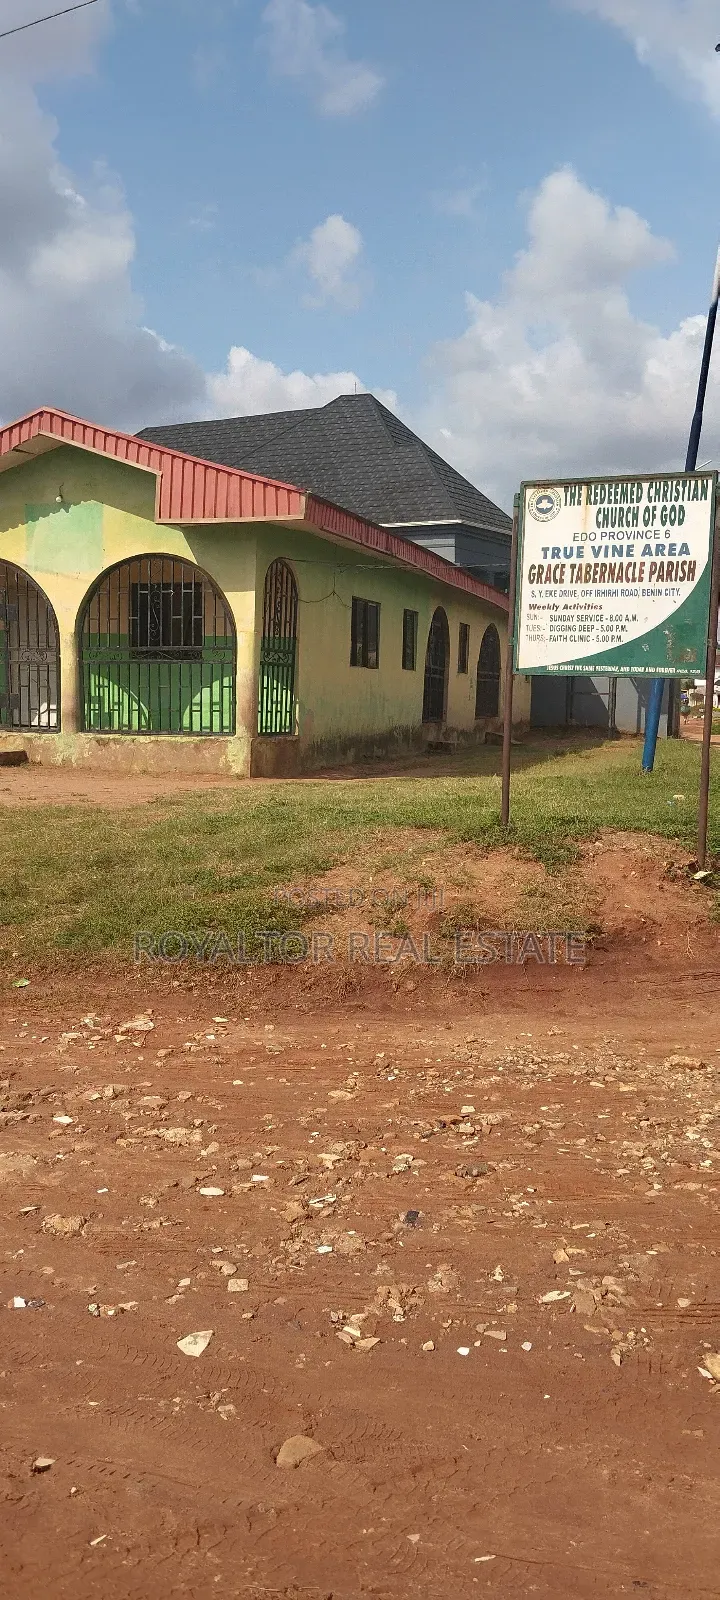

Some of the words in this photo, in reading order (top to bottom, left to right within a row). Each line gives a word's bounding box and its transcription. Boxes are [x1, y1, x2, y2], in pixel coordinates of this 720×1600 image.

[564, 486, 582, 506] THE
[586, 482, 643, 506] REDEEMED
[647, 479, 708, 503] CHRISTIAN
[596, 506, 638, 529] CHURCH
[643, 505, 656, 527] OF
[660, 504, 686, 527] GOD
[573, 532, 596, 541] EDO
[601, 530, 660, 541] PROVINCE
[664, 529, 670, 539] 6
[542, 546, 584, 559] TRUE
[591, 544, 635, 558] VINE
[641, 543, 690, 557] AREA
[528, 563, 565, 584] GRACE
[570, 561, 645, 584] TABERNACLE
[648, 560, 696, 582] PARISH
[539, 590, 543, 598] Y.
[559, 590, 579, 599] DRIVE,
[595, 589, 618, 597] IRHIRHI
